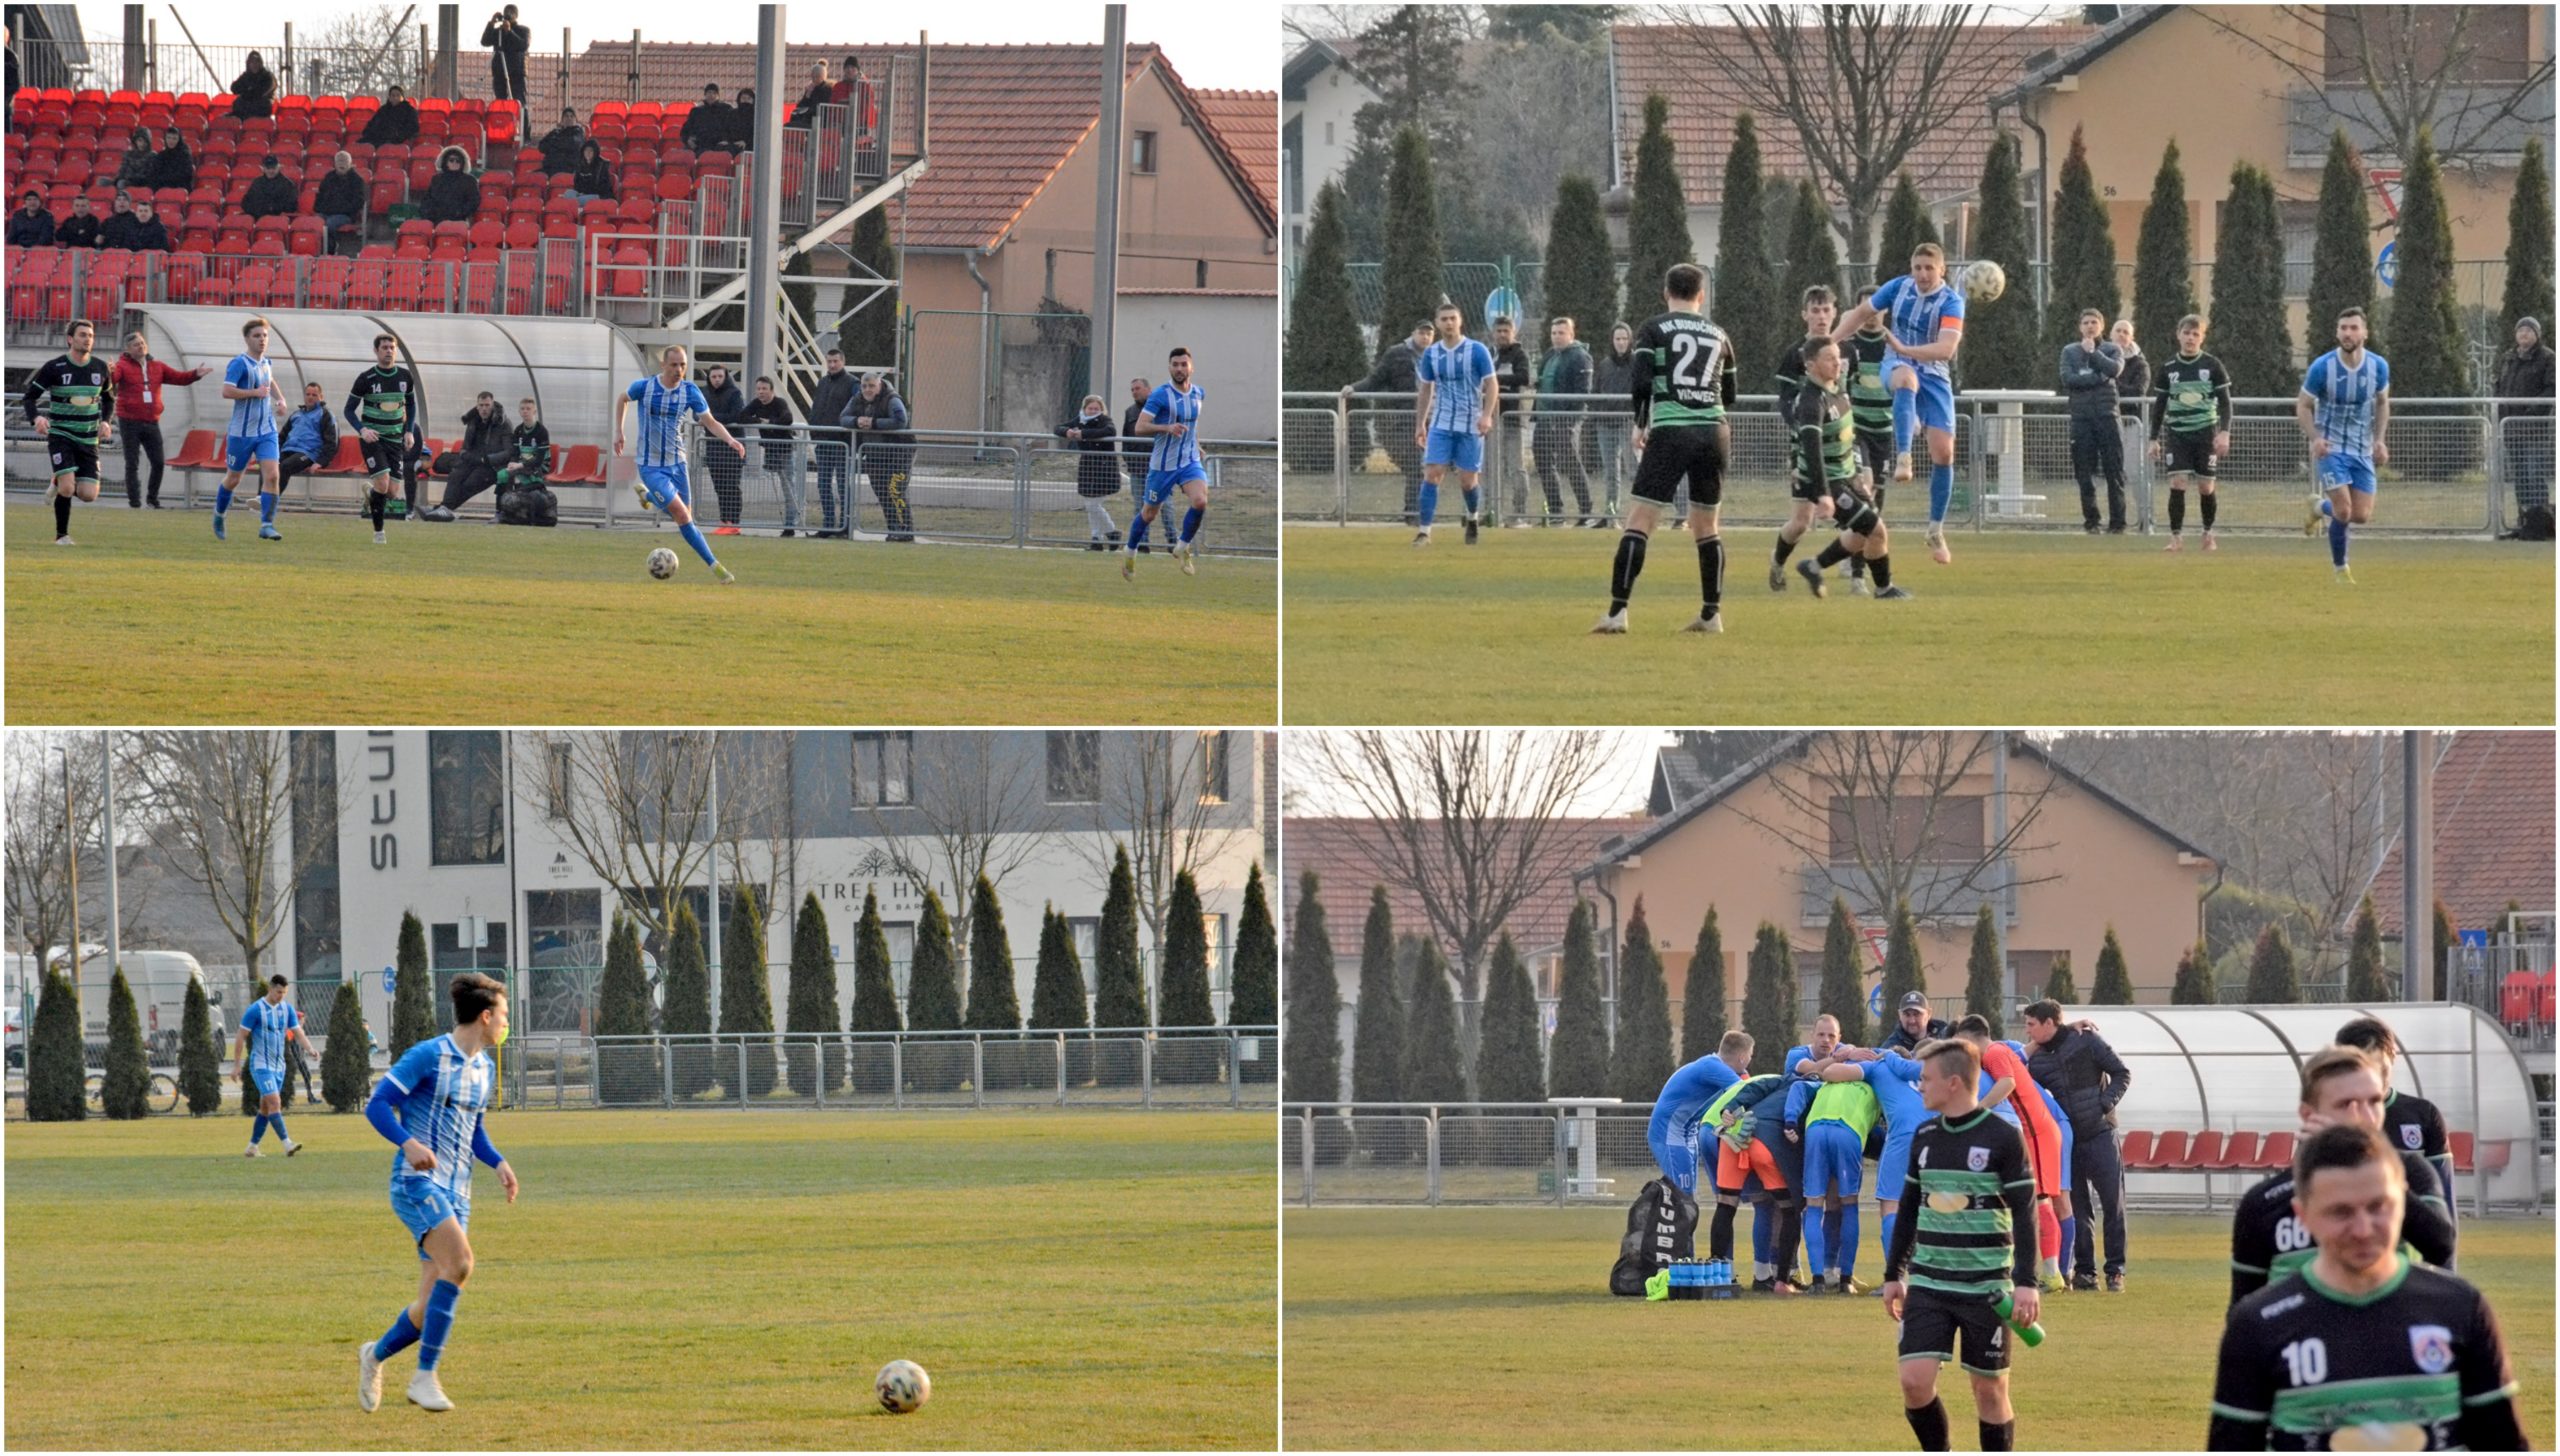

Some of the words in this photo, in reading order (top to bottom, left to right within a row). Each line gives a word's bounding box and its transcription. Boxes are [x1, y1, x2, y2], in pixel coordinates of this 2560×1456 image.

[2104, 186, 2117, 196] 56
[1659, 320, 1676, 334] NK
[1672, 333, 1721, 387] 27
[61, 373, 72, 385] 17
[2168, 372, 2180, 383] 22
[372, 384, 382, 393] 14
[228, 453, 236, 466] 19
[2323, 472, 2336, 487] 15
[1149, 489, 1158, 502] 15
[894, 881, 950, 898] HIL
[844, 904, 887, 912] CAE
[264, 1080, 274, 1092] 17
[1918, 1145, 1929, 1169] 4
[1678, 1173, 1690, 1188] 10
[423, 1195, 441, 1214] 7
[1990, 1326, 2002, 1348] 4
[2281, 1337, 2327, 1387] 10
